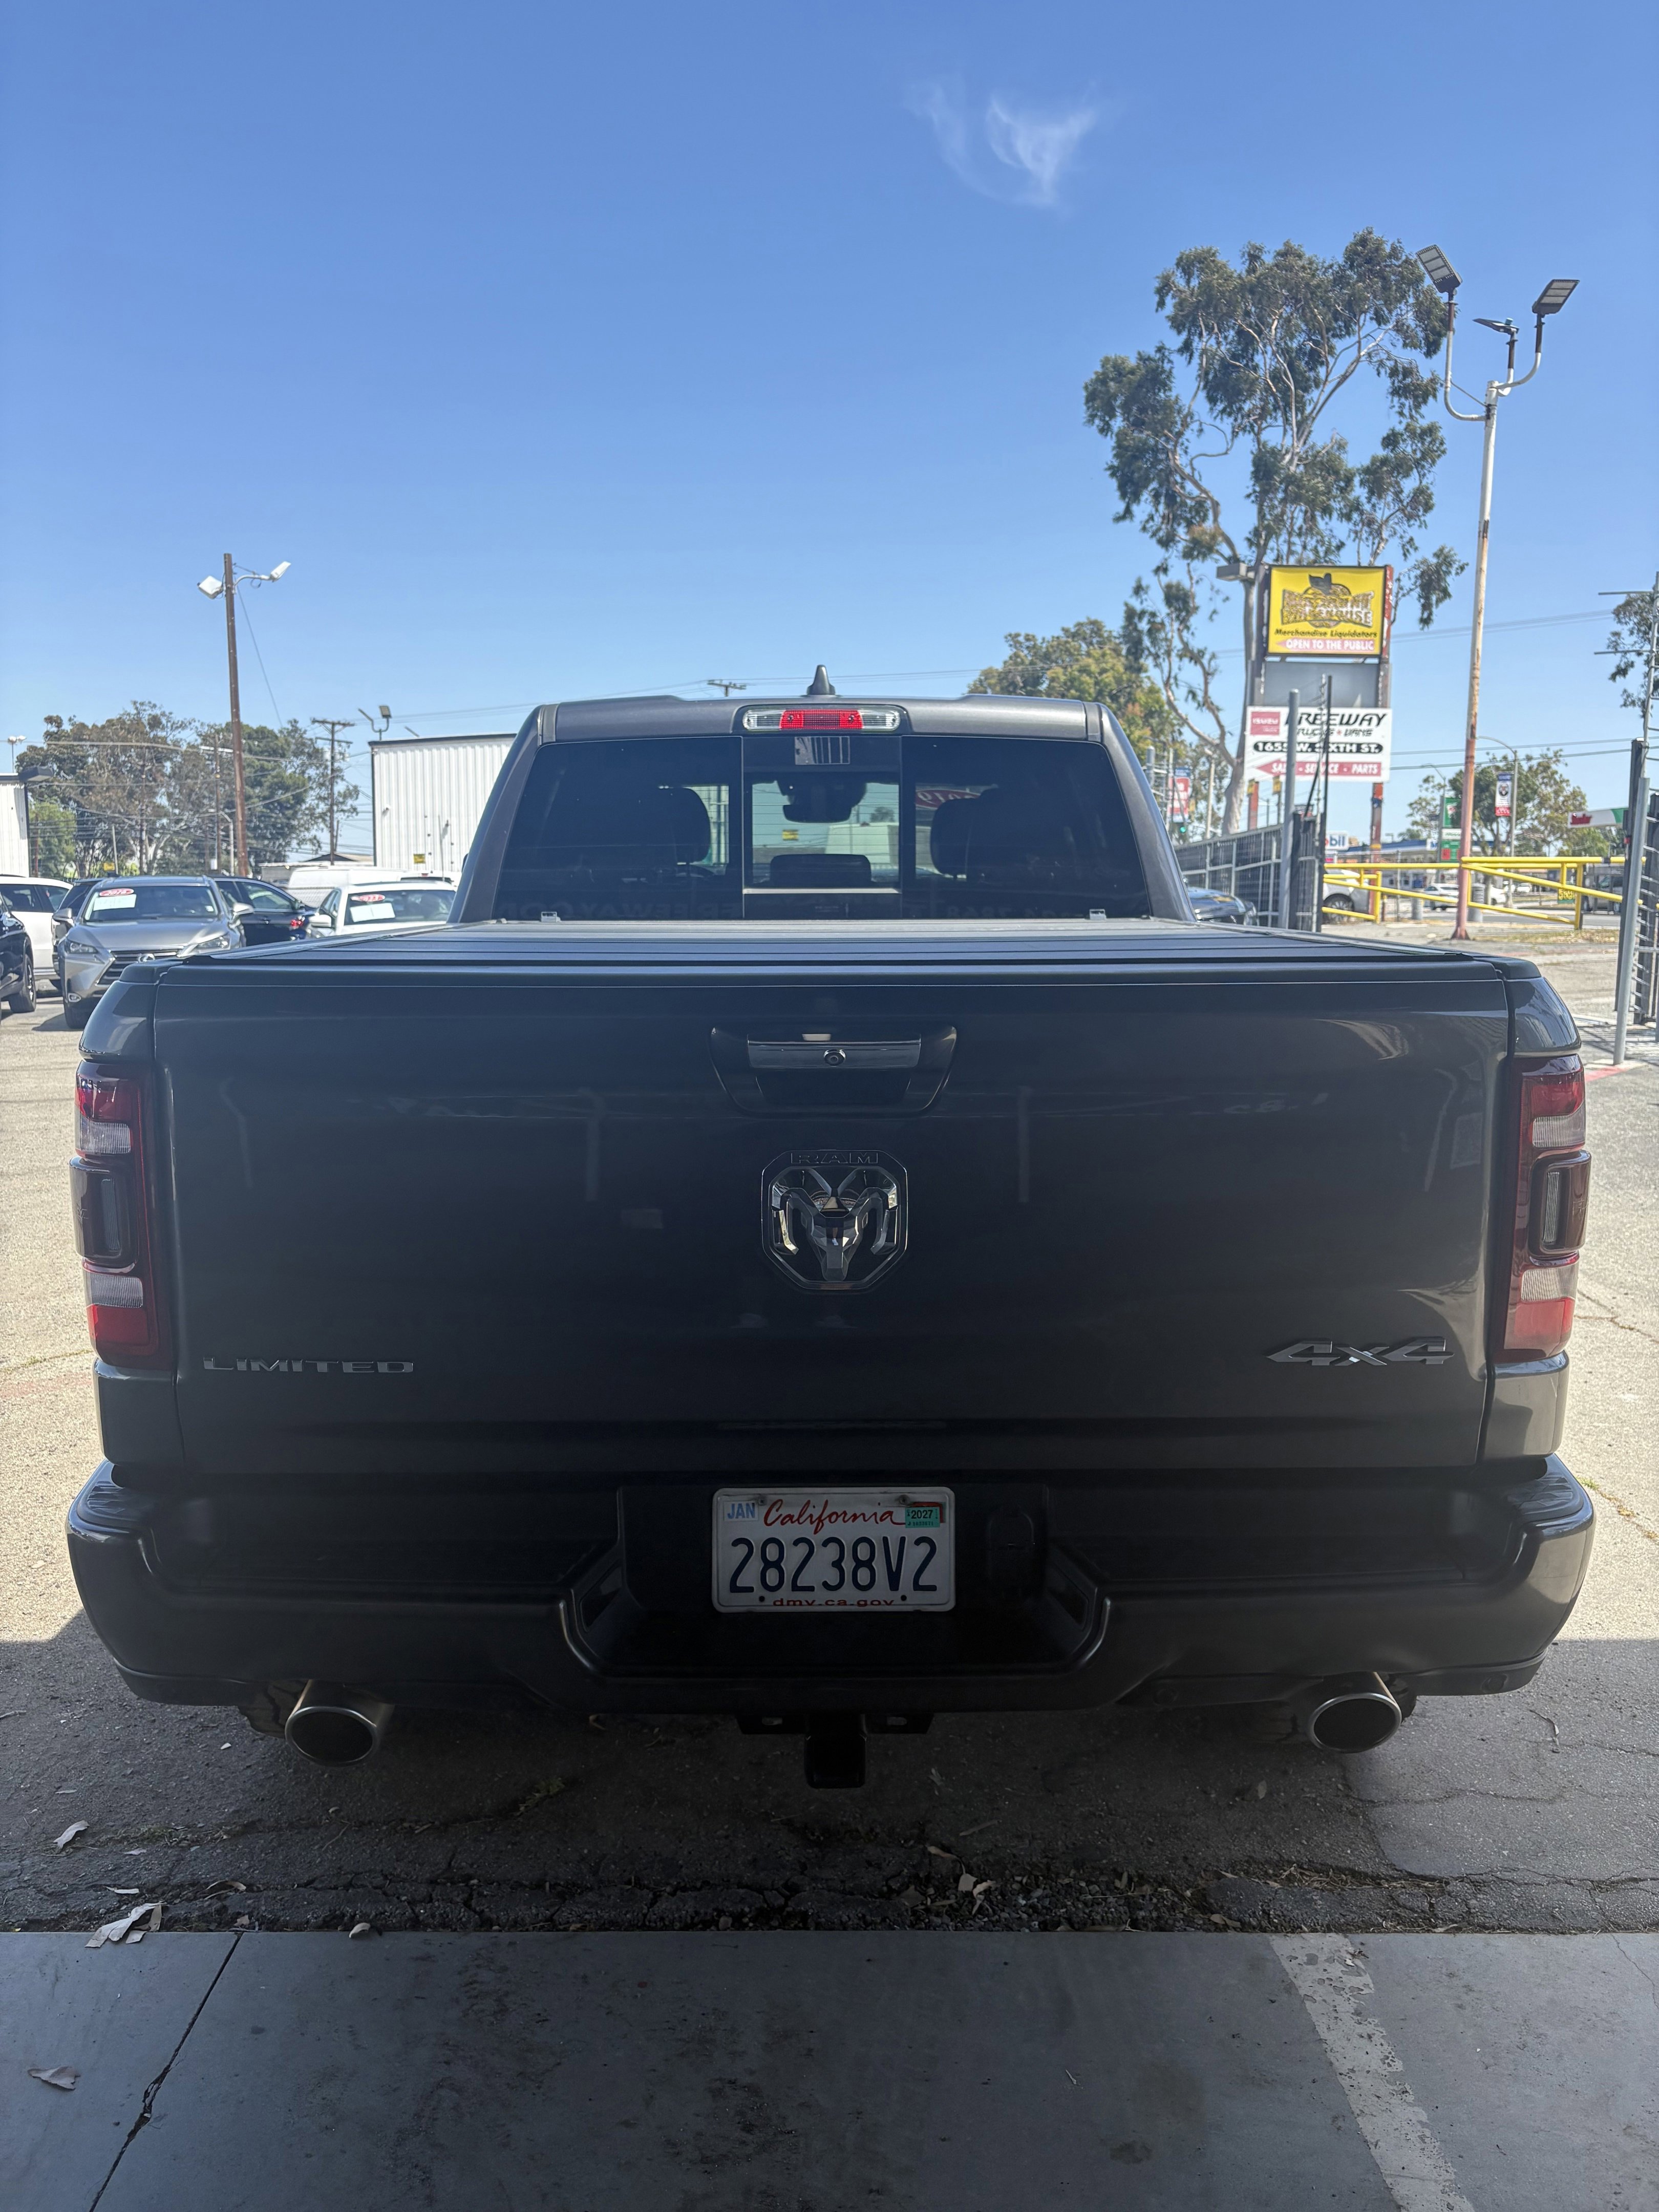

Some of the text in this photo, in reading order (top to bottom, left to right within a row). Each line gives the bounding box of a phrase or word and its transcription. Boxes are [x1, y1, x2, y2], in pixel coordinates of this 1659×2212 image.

[1274, 629, 1377, 639] Merchandise Liquidators
[1286, 639, 1374, 651] OPEN TO THE PUBLIC
[1286, 712, 1388, 727] REEWAY
[1314, 743, 1357, 753] SXTH
[1359, 743, 1379, 753] ST.
[1351, 763, 1378, 774] PARTS
[791, 1152, 879, 1164] RAM
[203, 1356, 415, 1373] LIMITED
[727, 1503, 756, 1519] JAN
[763, 1499, 906, 1535] California
[911, 1509, 933, 1519] 2027
[729, 1536, 938, 1593] 28238V2
[773, 1598, 895, 1607] dmv.ca.gov
